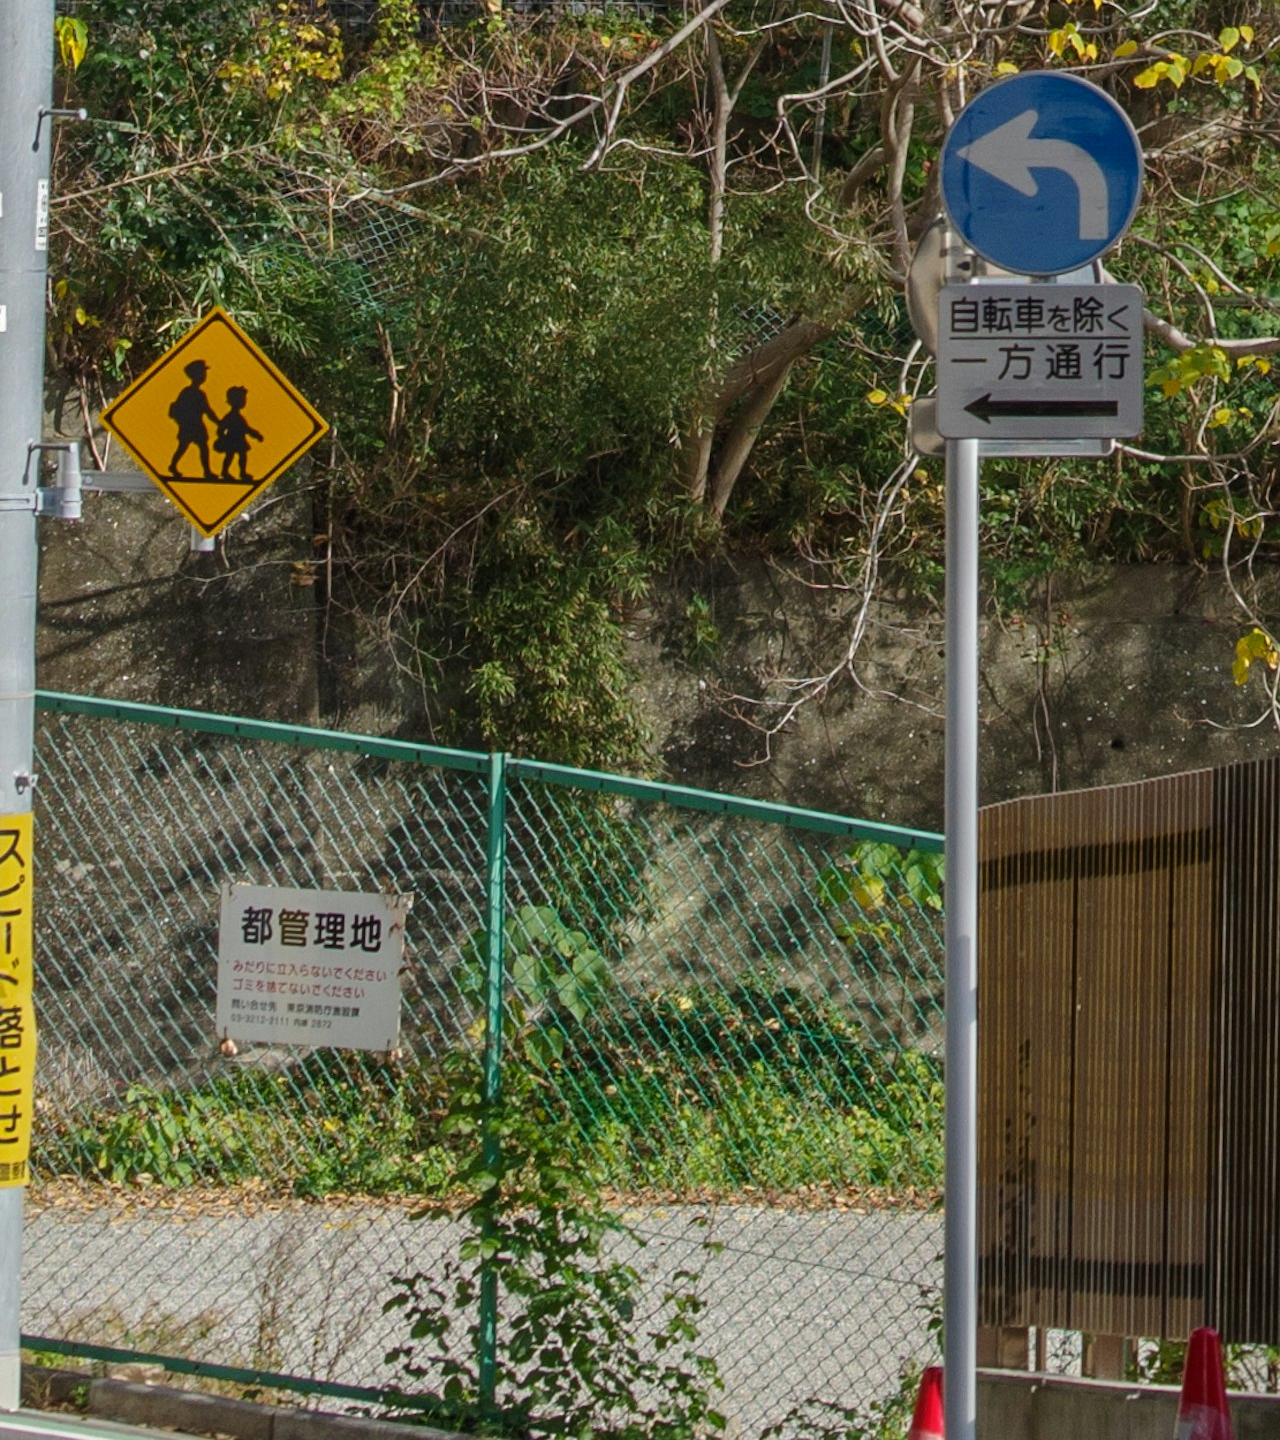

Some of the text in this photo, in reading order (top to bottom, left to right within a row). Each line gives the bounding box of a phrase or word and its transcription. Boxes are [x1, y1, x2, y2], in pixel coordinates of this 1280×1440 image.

[951, 296, 1129, 334] 自転車を除く
[951, 343, 1131, 380] 一方通行
[241, 906, 382, 953] 都管理地
[232, 959, 387, 982] みだりに立入らないでください
[232, 979, 365, 999] ゴミを捨てないでください
